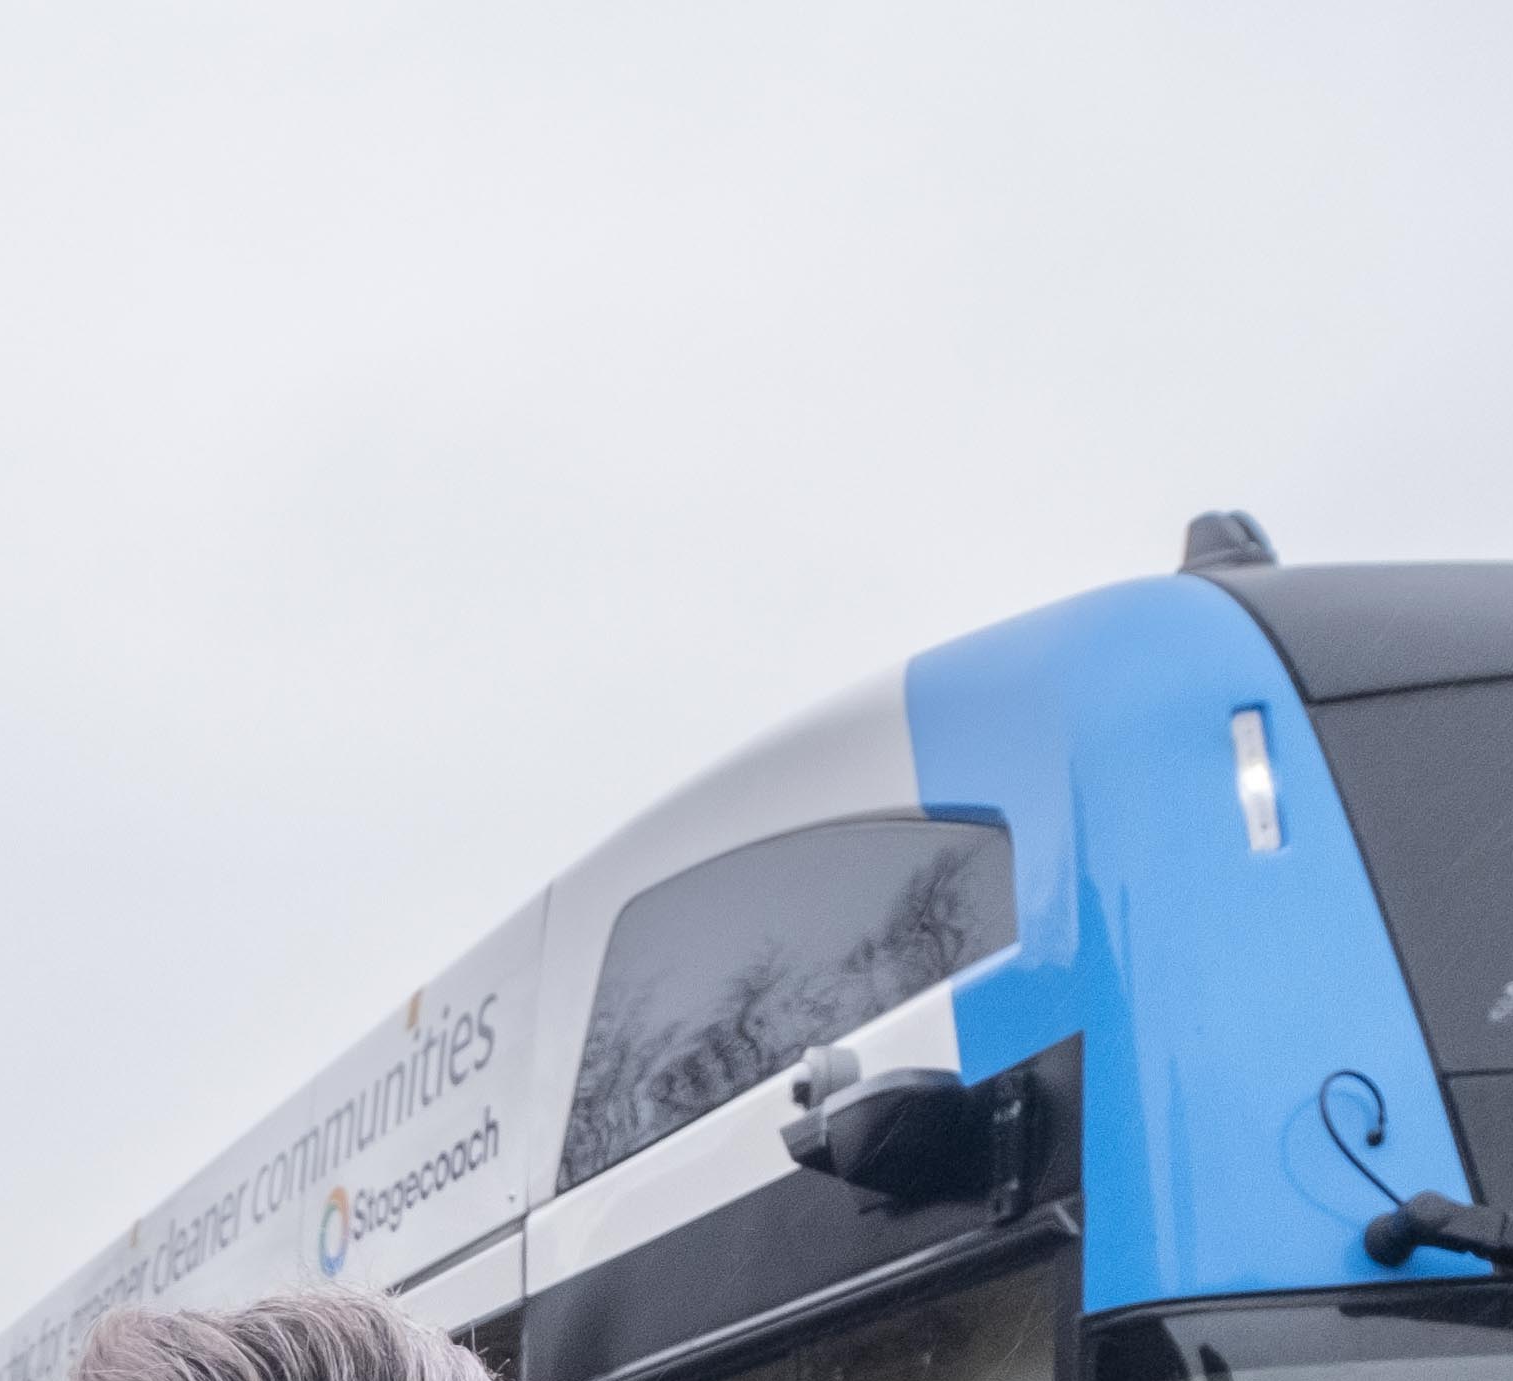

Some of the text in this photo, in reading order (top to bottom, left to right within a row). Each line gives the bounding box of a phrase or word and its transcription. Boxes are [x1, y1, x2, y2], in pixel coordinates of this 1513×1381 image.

[152, 1179, 249, 1296] cleaner
[251, 992, 499, 1226] communities
[352, 1104, 501, 1242] Stagecoach
